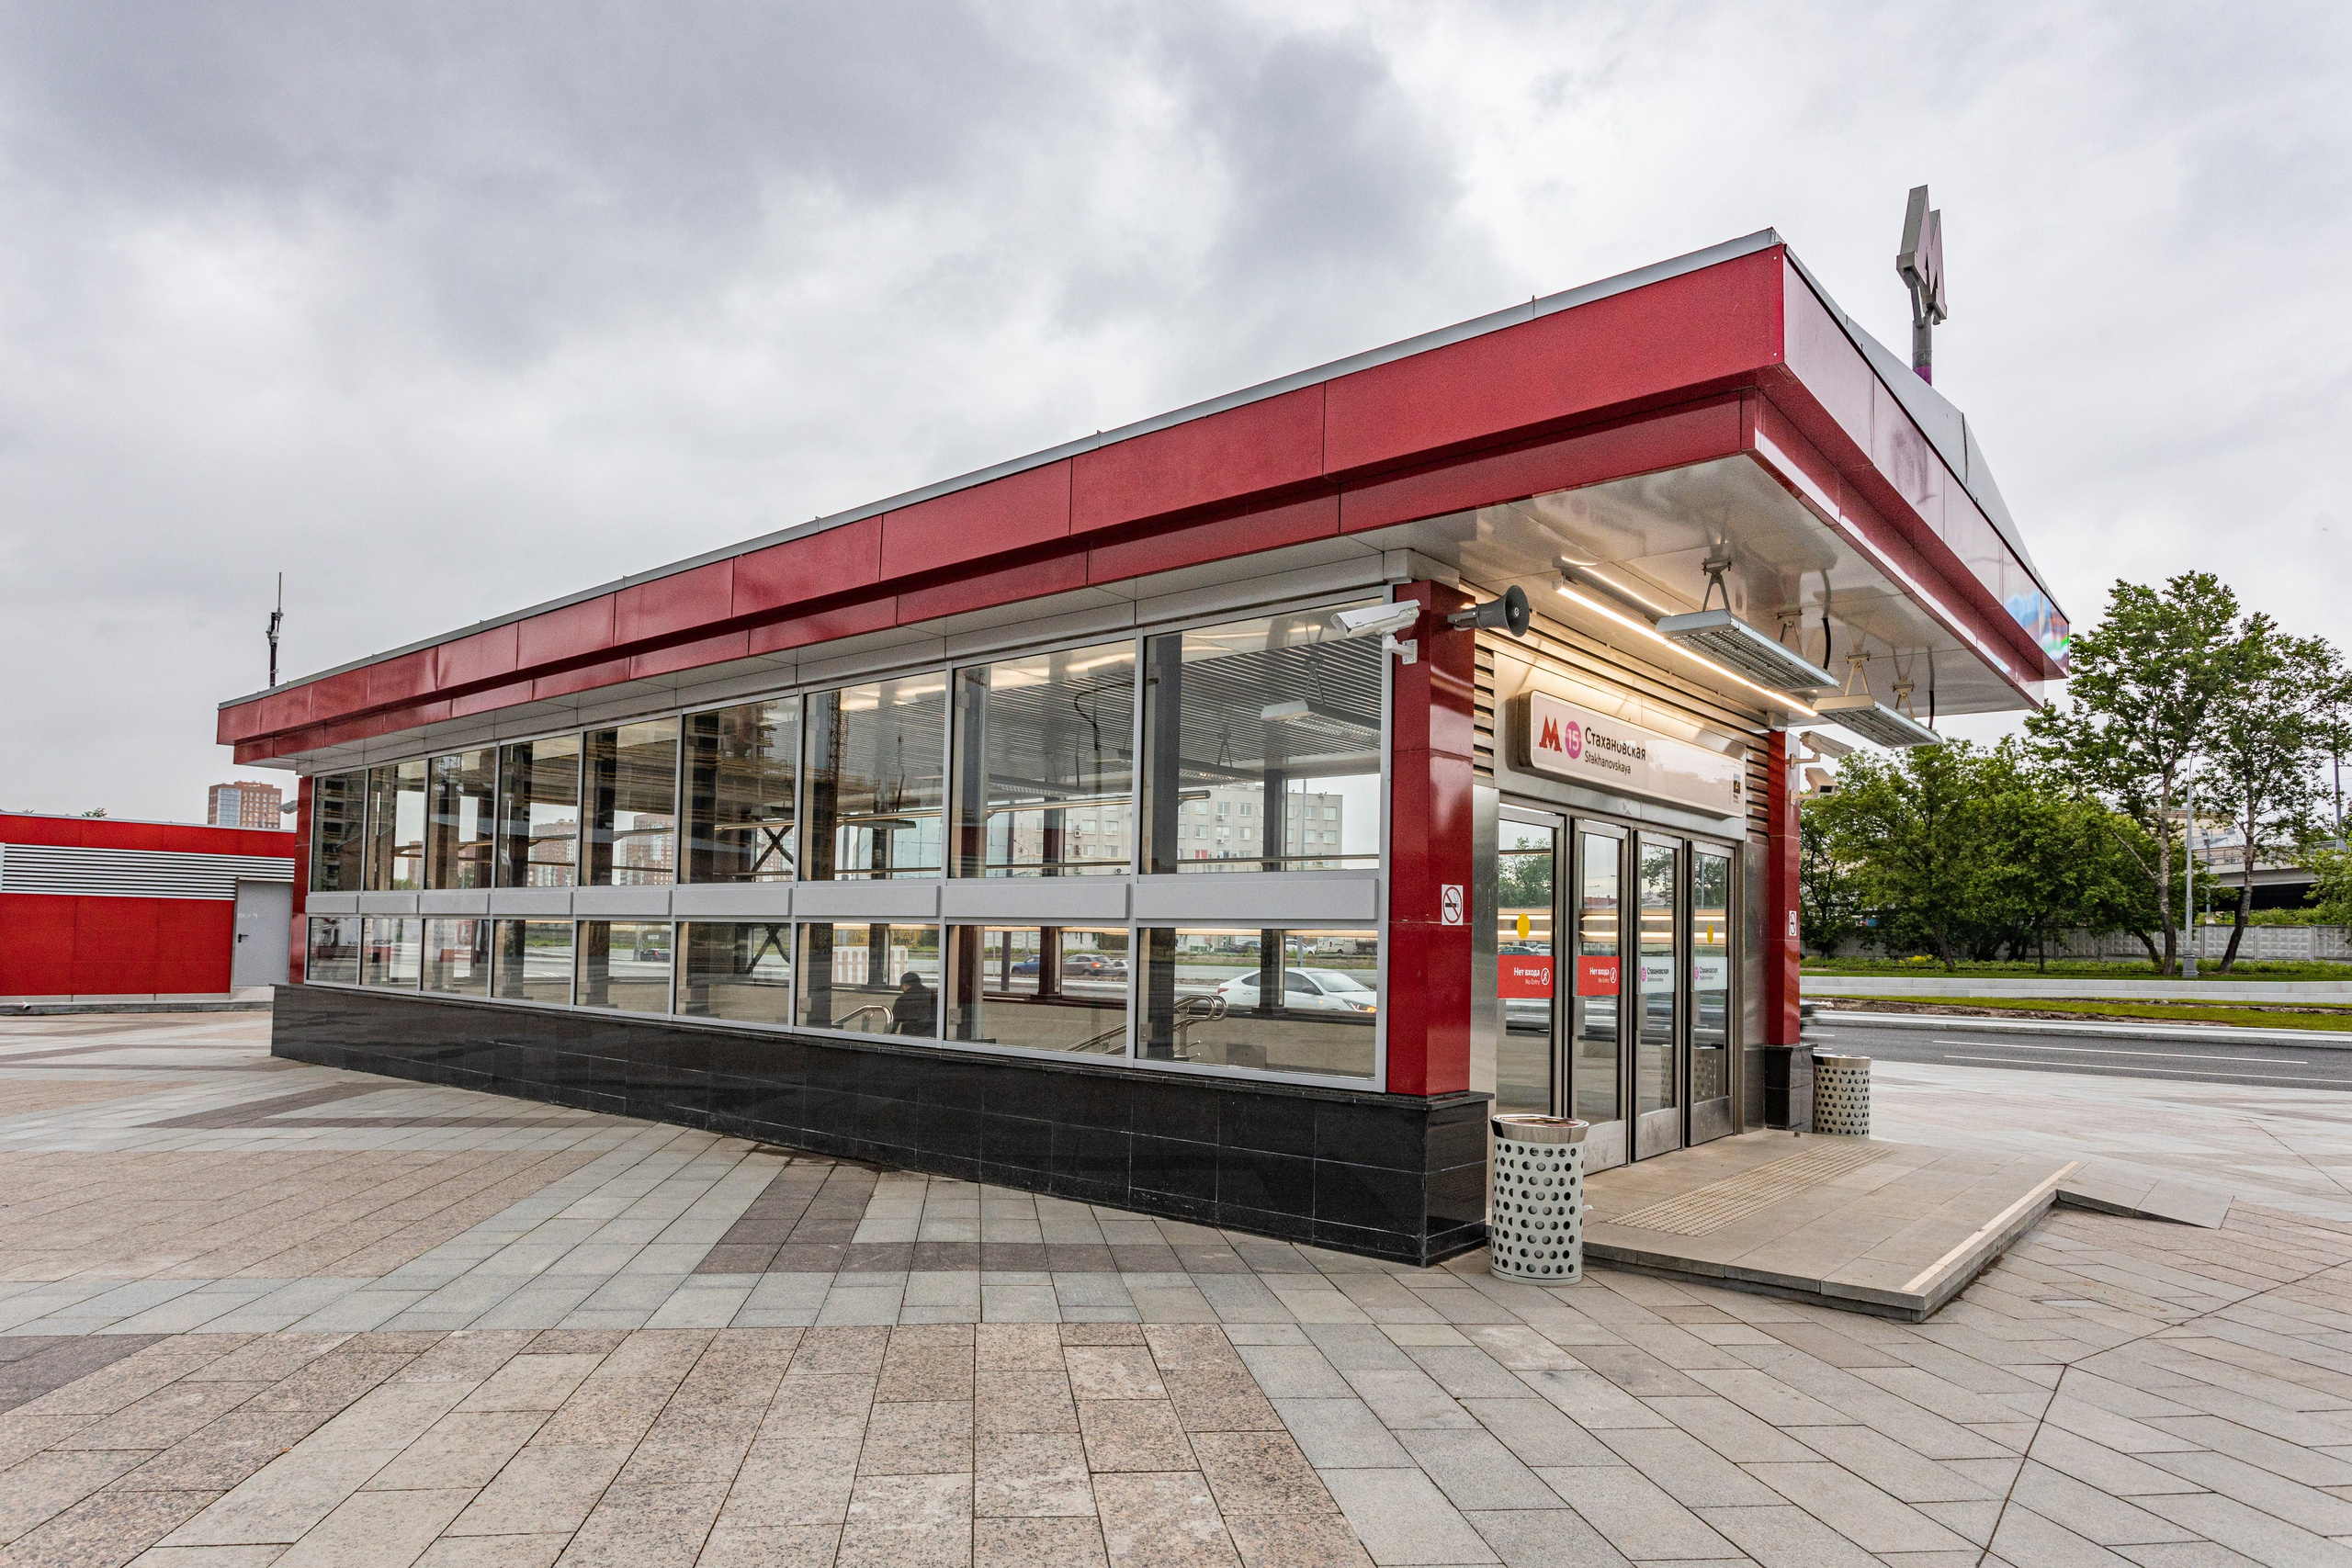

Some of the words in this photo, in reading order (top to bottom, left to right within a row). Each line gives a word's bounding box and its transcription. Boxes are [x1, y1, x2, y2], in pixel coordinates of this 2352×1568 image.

[1567, 728, 1579, 751] 15
[1585, 727, 1646, 761] Стахановская
[1585, 750, 1632, 775] Stakhanovskaya
[1513, 967, 1524, 976] Нет
[1525, 969, 1540, 977] входа
